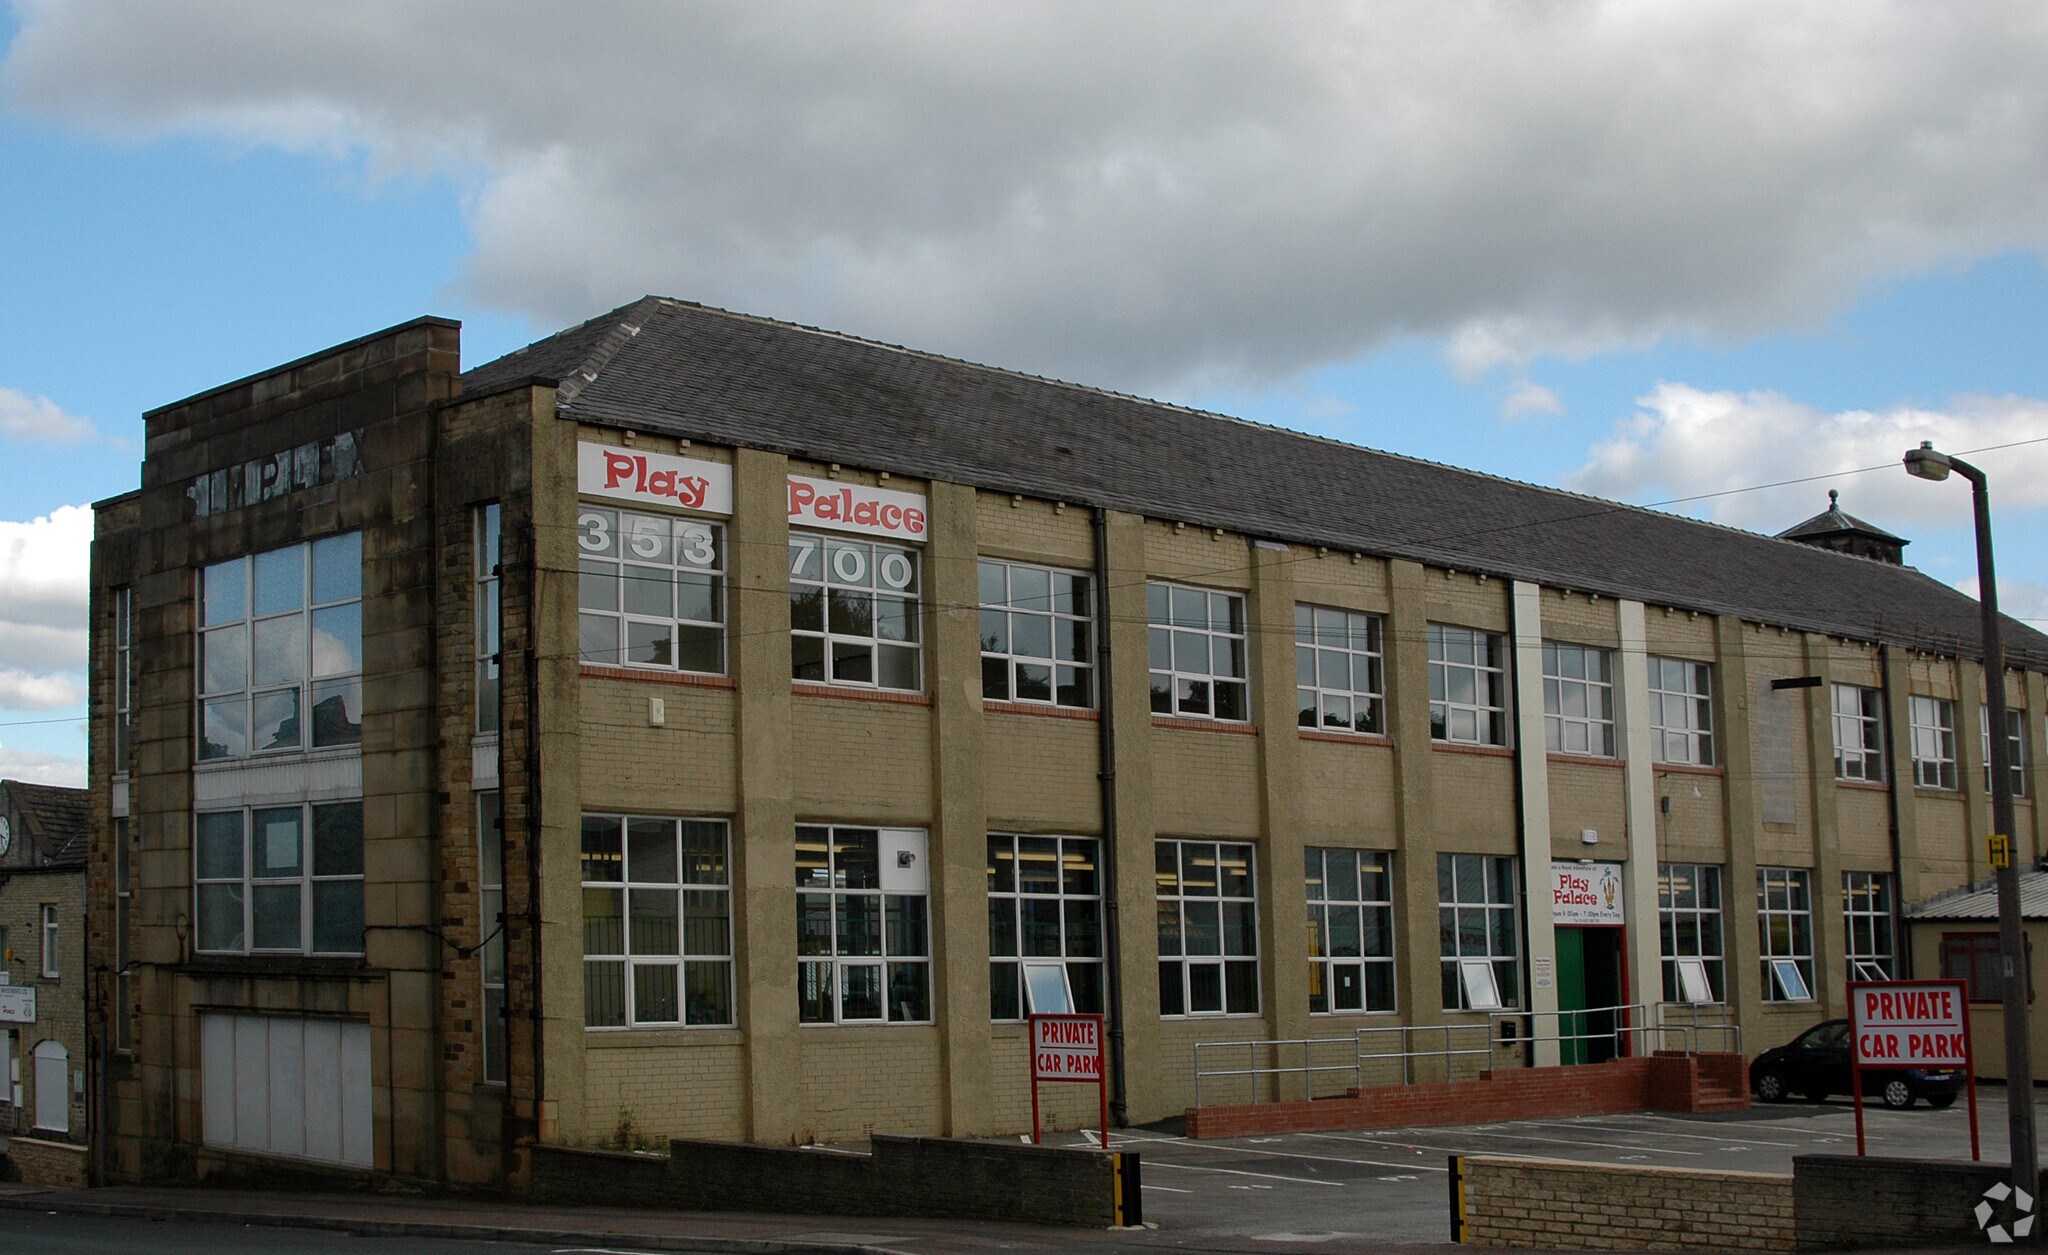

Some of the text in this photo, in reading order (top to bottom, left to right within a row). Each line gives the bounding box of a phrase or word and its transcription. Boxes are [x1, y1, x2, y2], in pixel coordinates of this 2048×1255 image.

[603, 449, 710, 509] Play
[788, 479, 925, 534] Palace
[578, 513, 716, 565] 353
[790, 540, 912, 588] 700
[1559, 874, 1590, 892] Play
[1553, 889, 1597, 905] Palace
[1600, 911, 1612, 919] Every
[1866, 991, 1953, 1020] PRIVATE
[1042, 1021, 1094, 1045] PRIVATE
[1860, 1033, 1966, 1058] CAR PARK
[1037, 1053, 1100, 1074] CAR PARK
